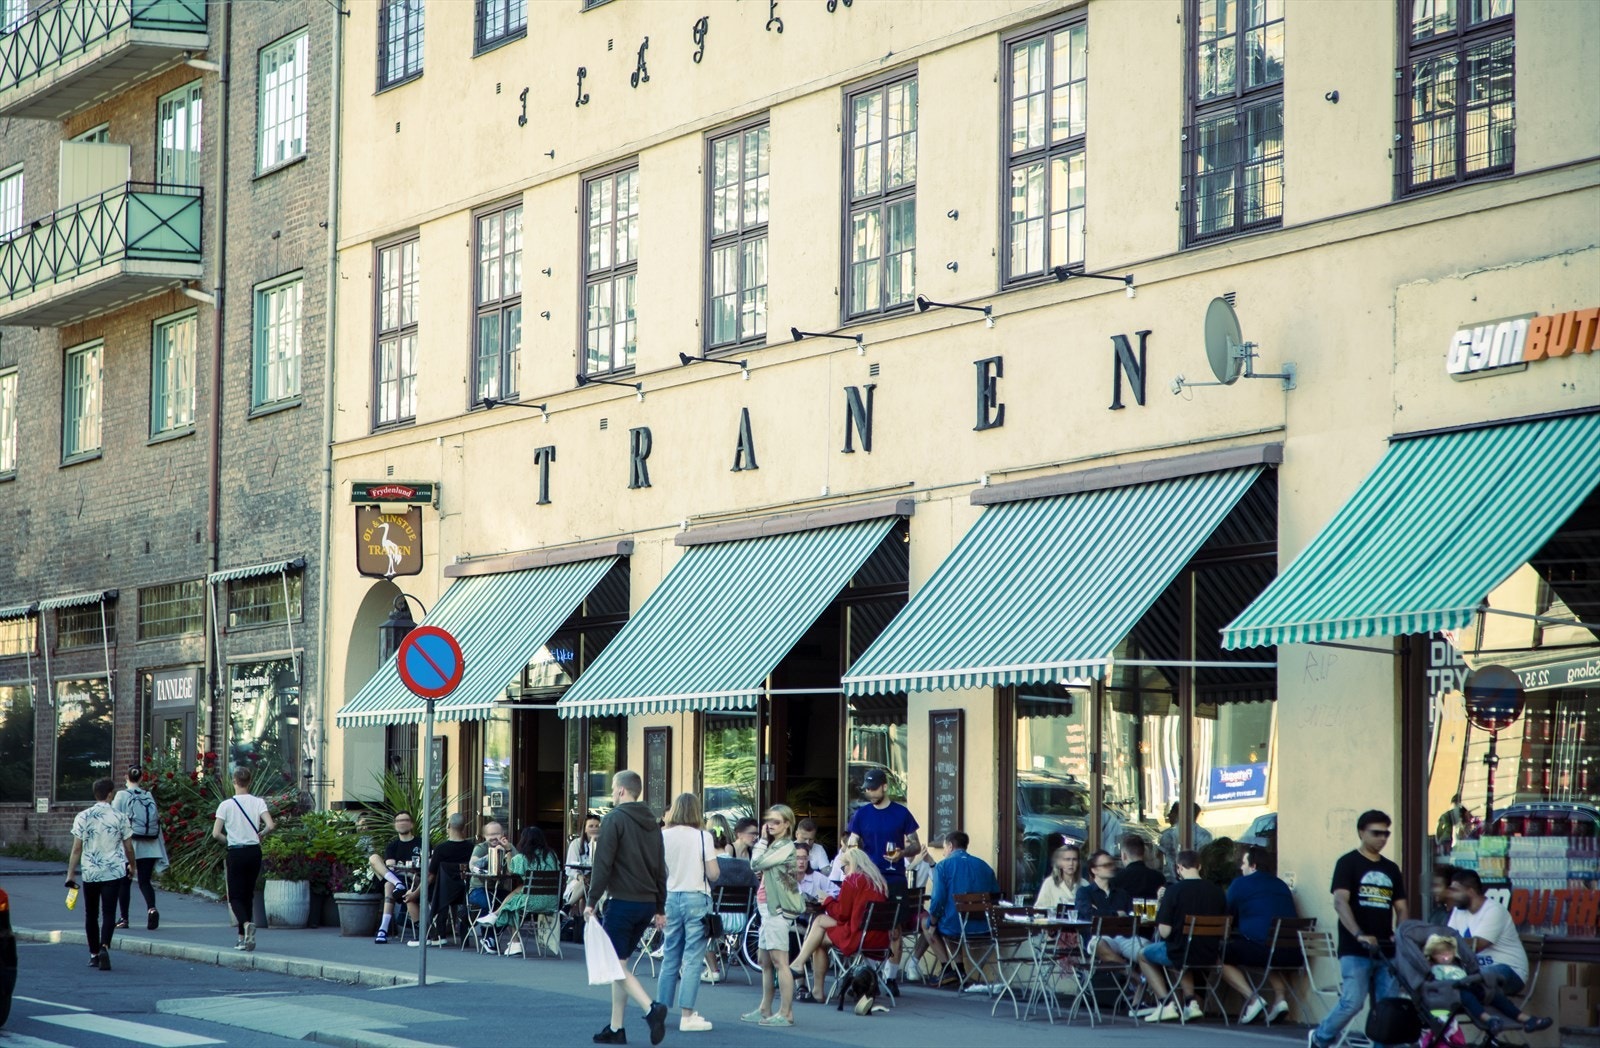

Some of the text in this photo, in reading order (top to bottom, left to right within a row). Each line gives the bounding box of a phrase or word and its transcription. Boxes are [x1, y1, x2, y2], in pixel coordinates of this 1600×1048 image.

[533, 329, 1152, 505] TRANEN
[371, 486, 412, 498] Frydenlund
[378, 515, 416, 541] VINSTUE
[1431, 641, 1466, 667] DIE
[156, 677, 193, 701] TANNLEGE
[1426, 667, 1470, 695] TRY
